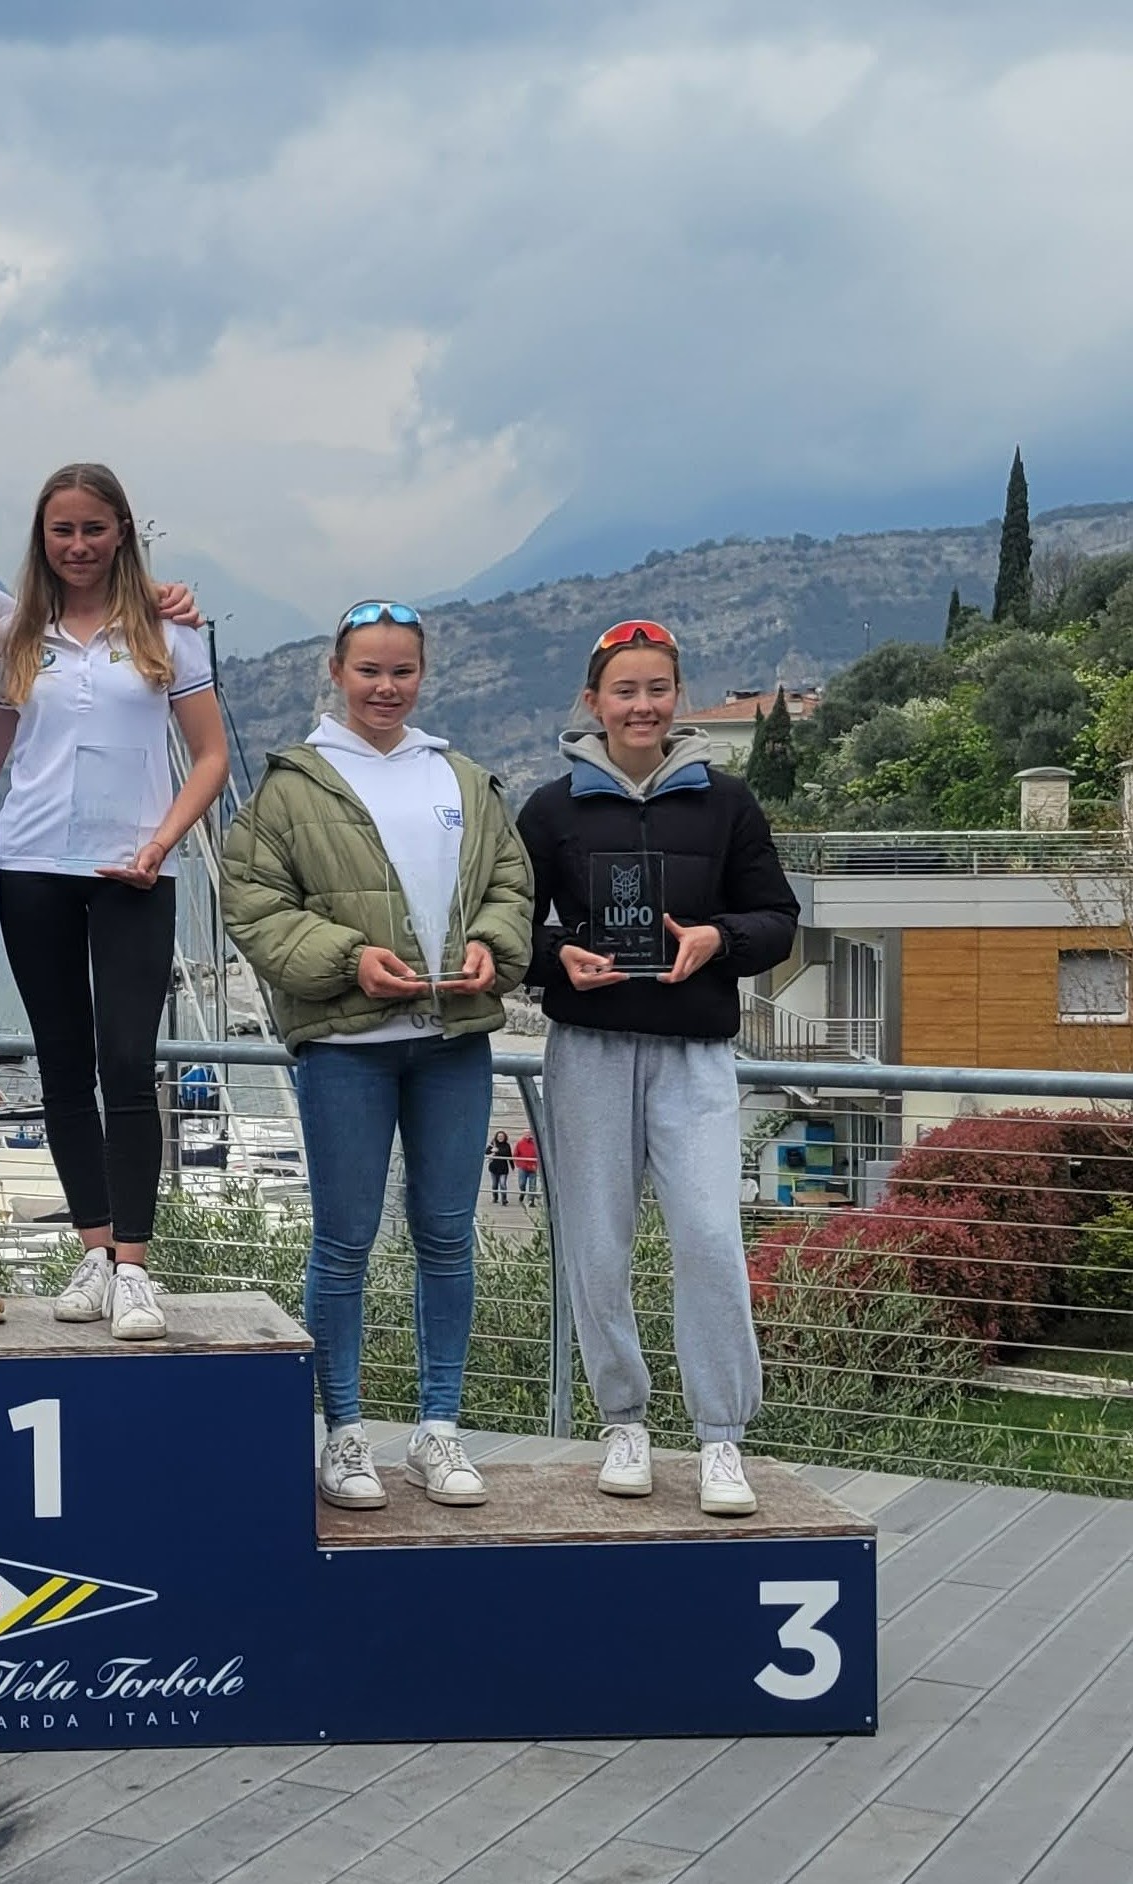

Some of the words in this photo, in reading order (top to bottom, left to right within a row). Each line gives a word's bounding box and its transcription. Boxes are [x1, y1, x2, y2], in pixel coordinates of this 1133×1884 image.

[604, 905, 653, 927] LUPO
[9, 1399, 63, 1519] 1
[754, 1580, 842, 1700] 3
[85, 1655, 245, 1700] Torbole
[109, 1710, 201, 1727] ITALY
